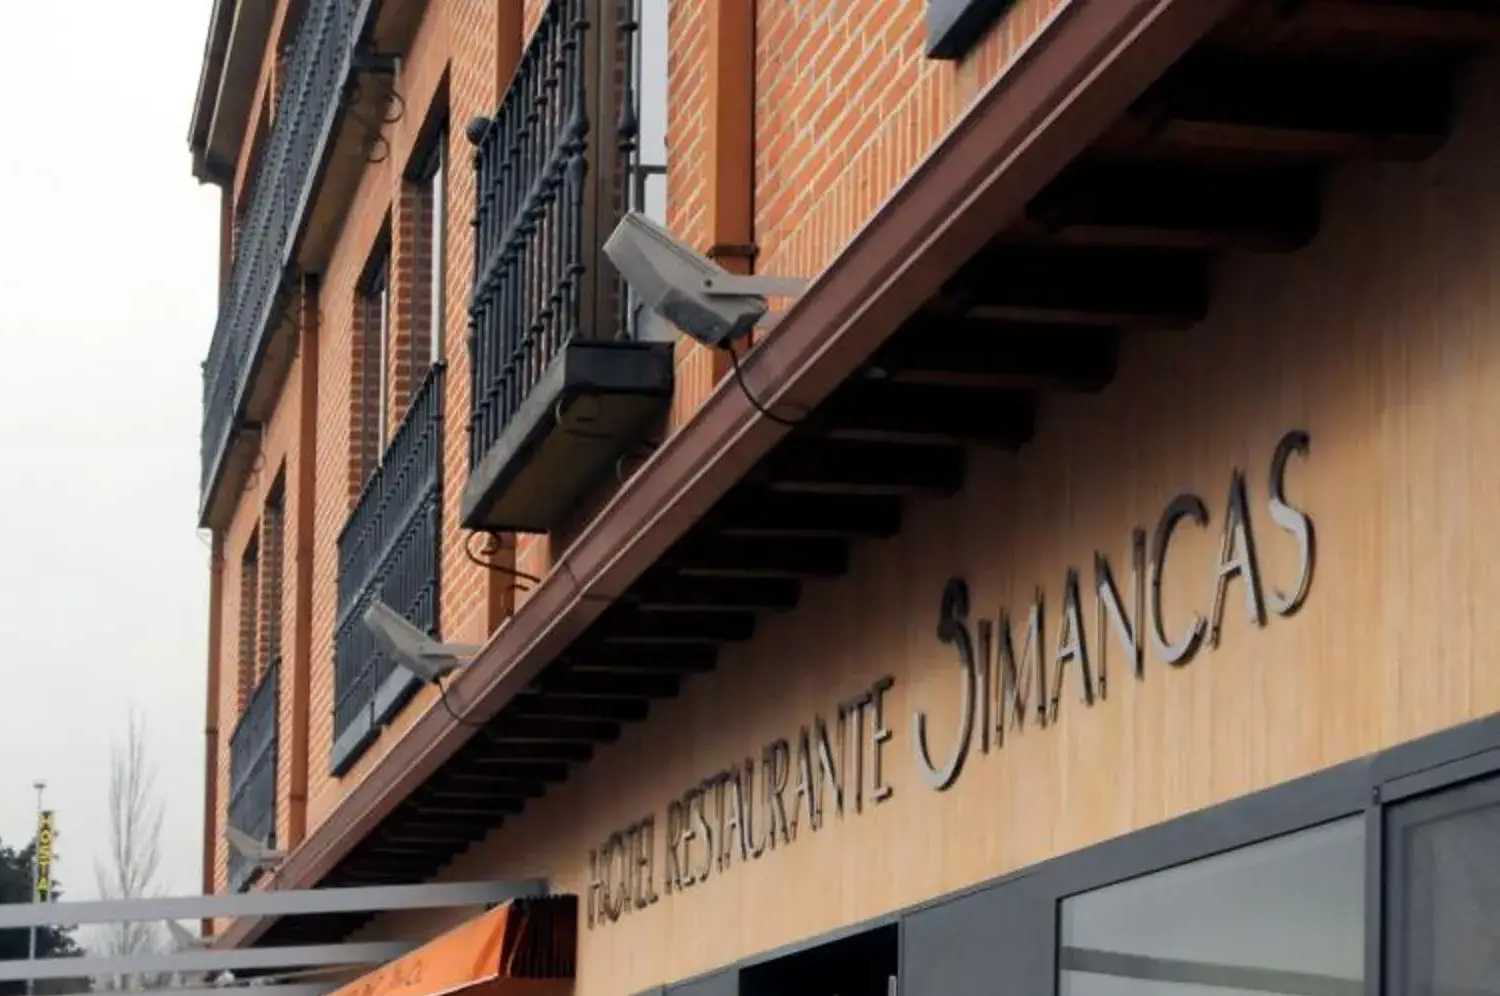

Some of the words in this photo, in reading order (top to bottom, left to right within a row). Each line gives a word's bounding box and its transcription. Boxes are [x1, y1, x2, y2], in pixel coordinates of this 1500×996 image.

[587, 814, 659, 929] HOTEL
[664, 678, 895, 892] RESTAURANTE
[913, 429, 1316, 792] SIMANCAS
